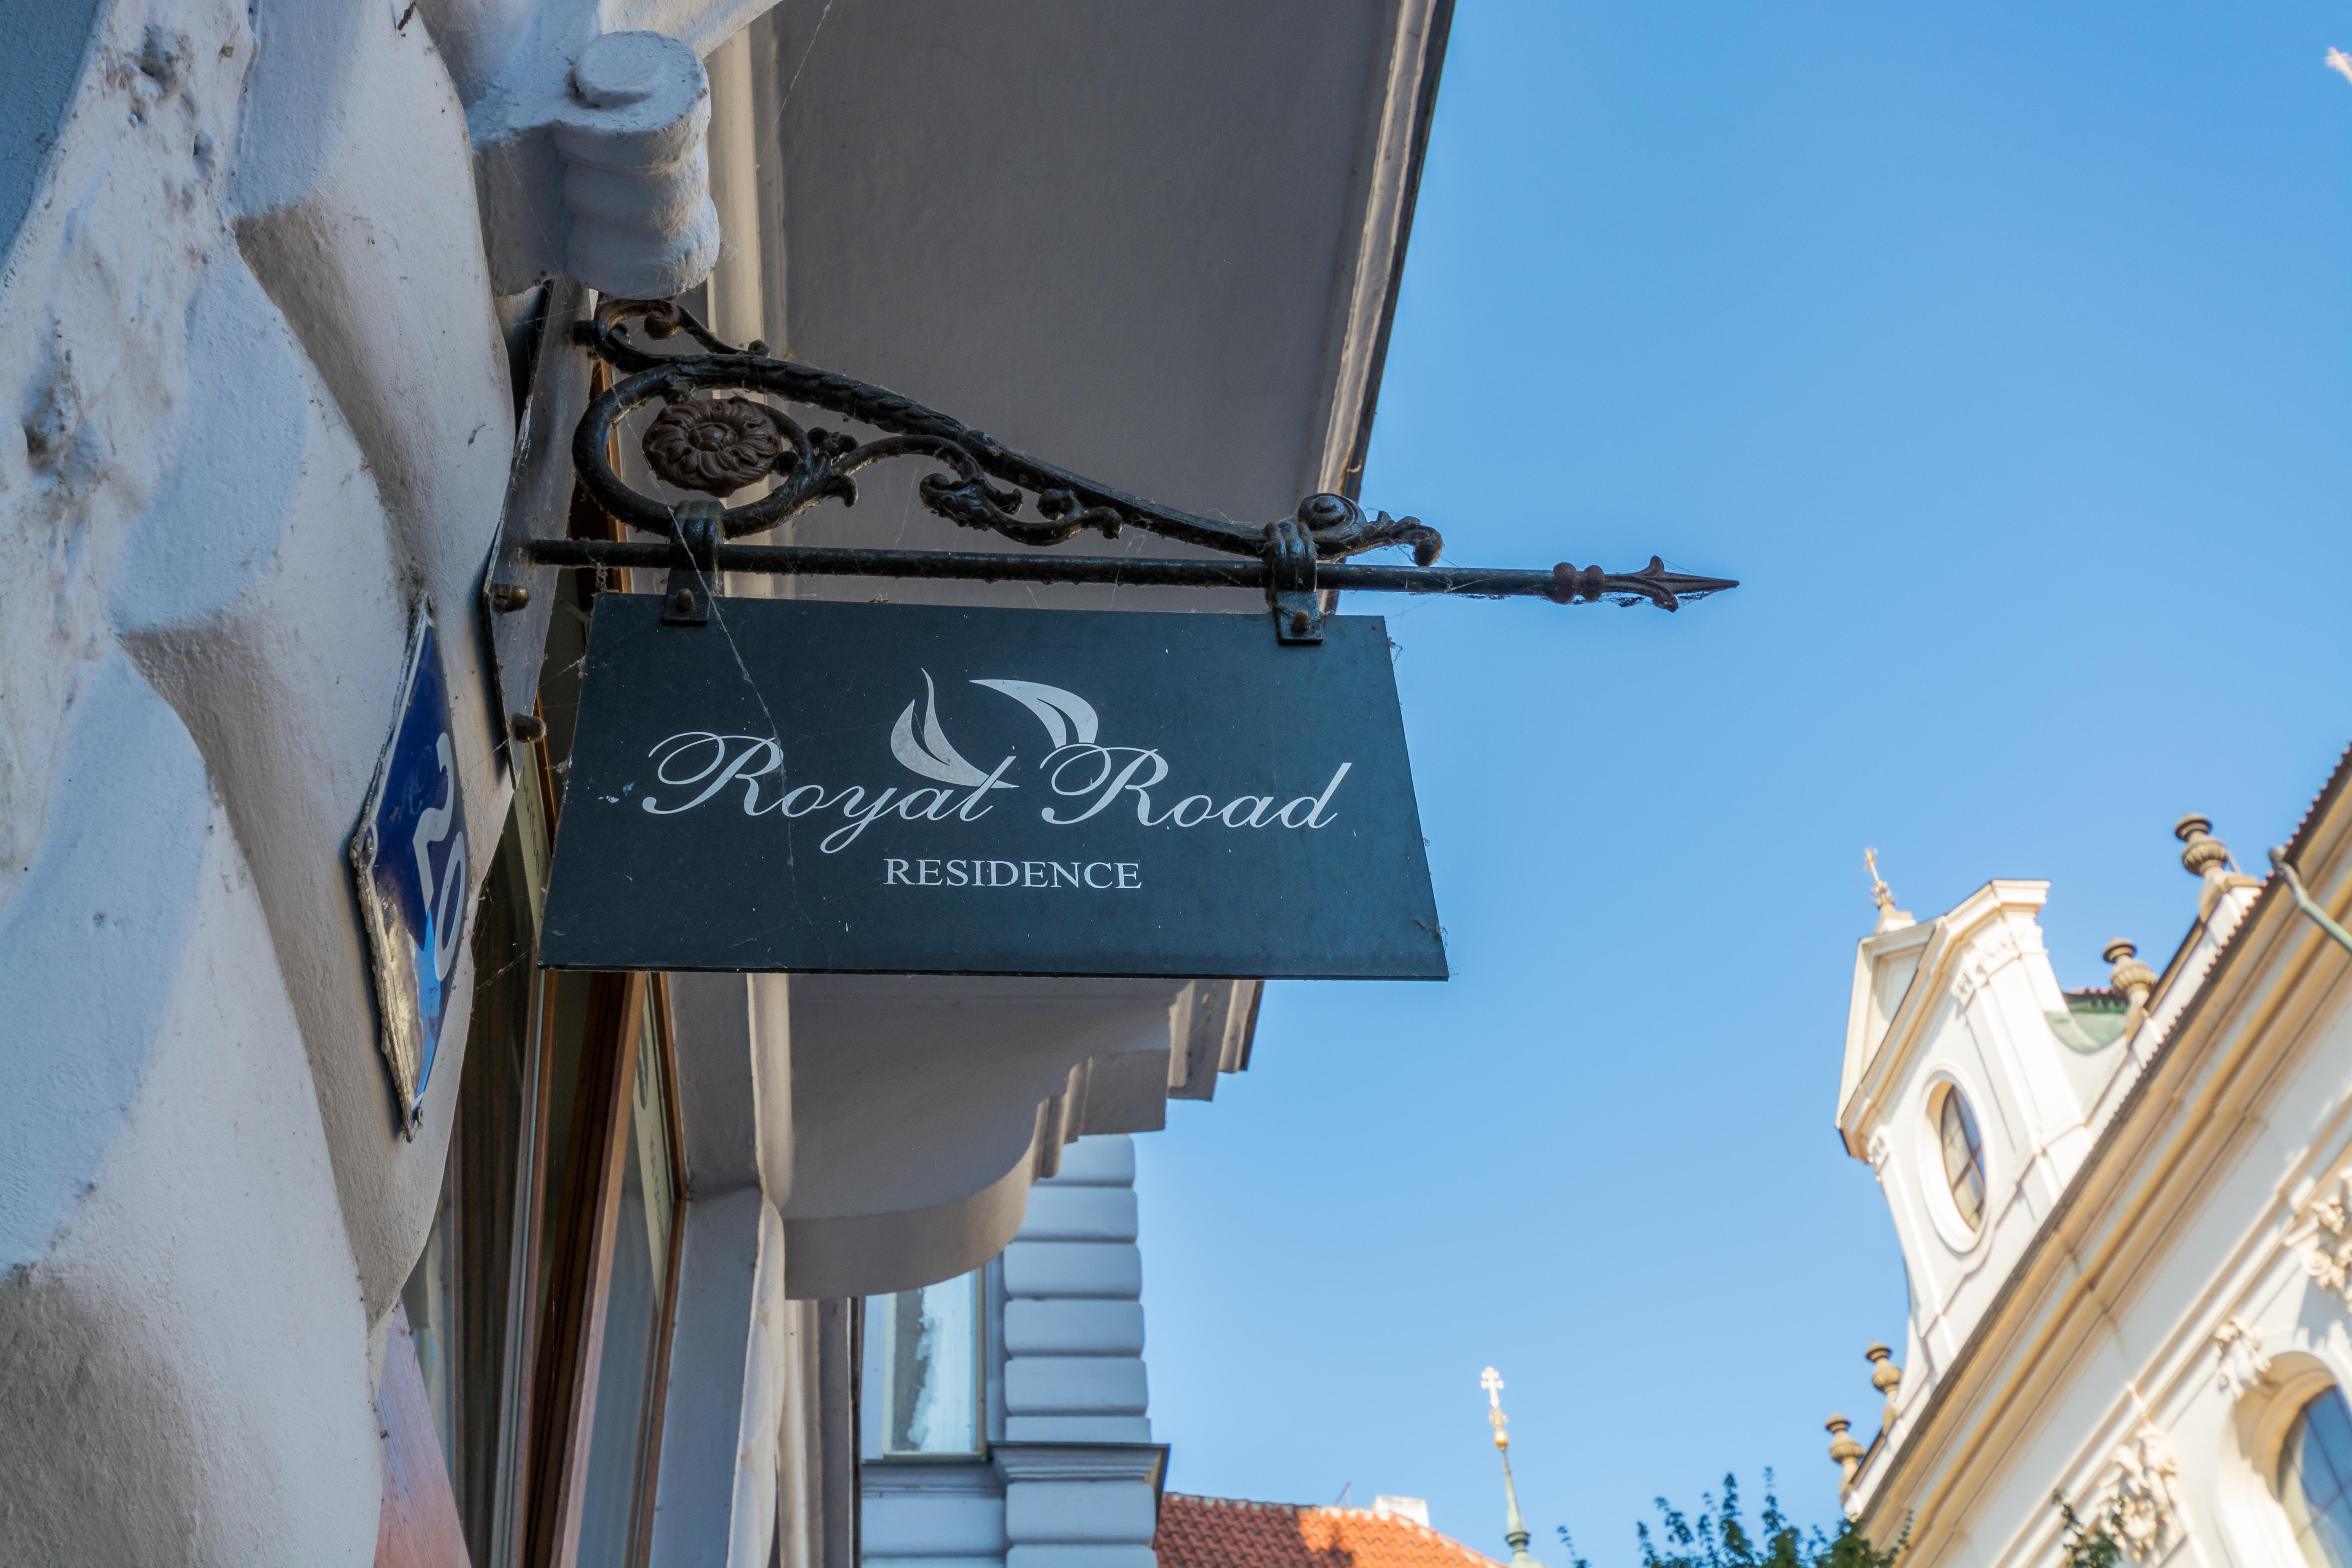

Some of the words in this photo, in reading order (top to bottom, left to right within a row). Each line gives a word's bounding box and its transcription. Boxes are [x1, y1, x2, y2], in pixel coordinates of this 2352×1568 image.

[642, 732, 1017, 854] Royal
[1040, 743, 1352, 829] Road
[413, 732, 466, 981] 20
[884, 858, 1142, 889] RESIDENCE
